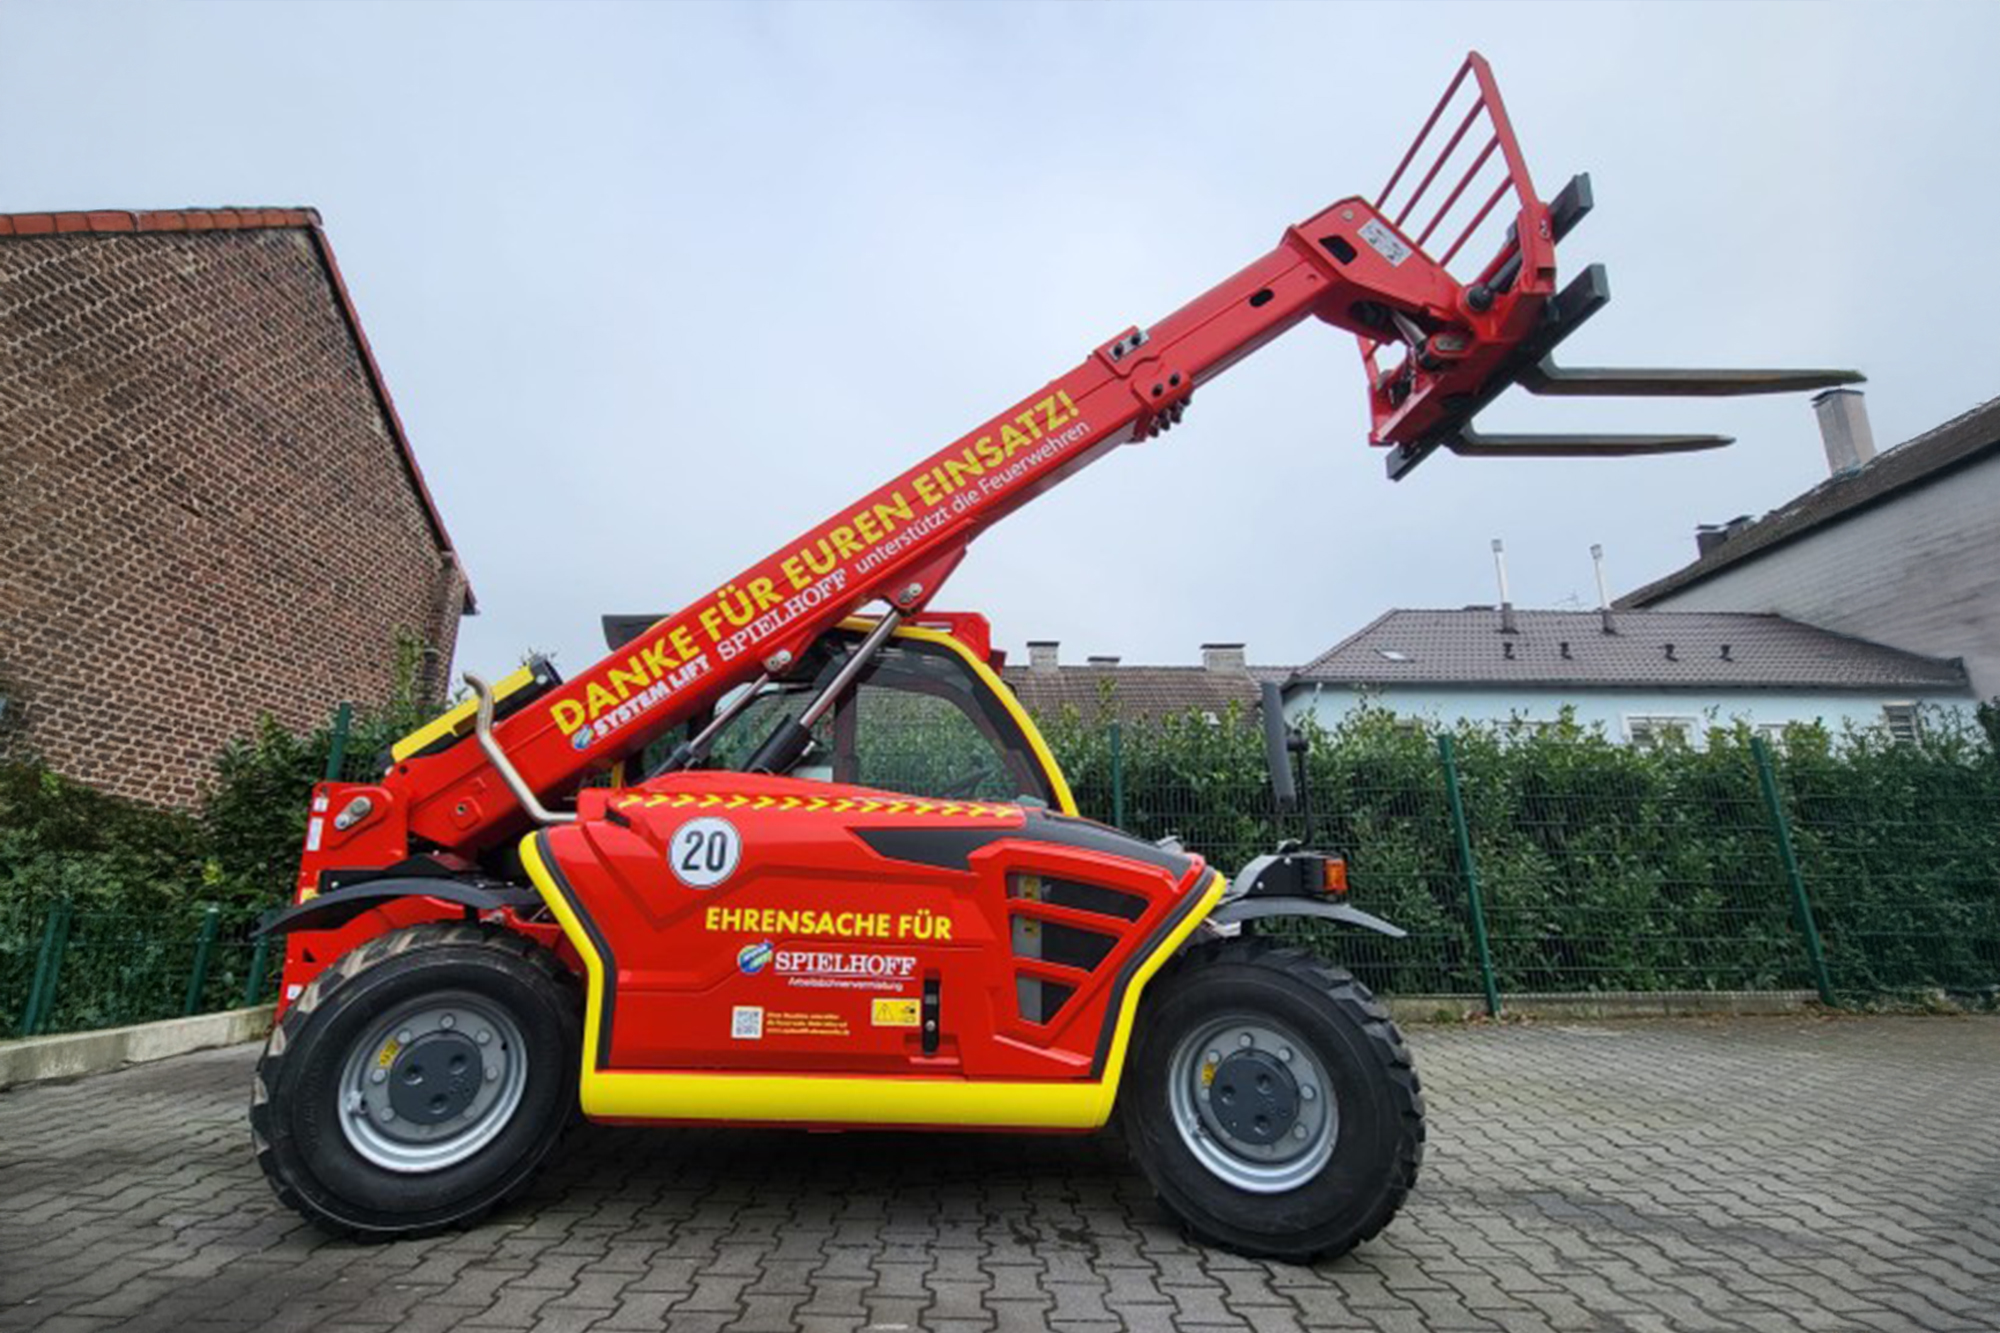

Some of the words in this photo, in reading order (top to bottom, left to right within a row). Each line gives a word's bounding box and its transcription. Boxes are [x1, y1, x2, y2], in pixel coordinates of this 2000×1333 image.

[550, 625, 701, 735] DANKE
[699, 577, 784, 642] FÜR
[780, 491, 915, 590] EUREN
[911, 389, 1080, 507] EINSATZ!
[593, 680, 673, 739] SYSTEM
[667, 653, 711, 690] LIFT
[716, 568, 847, 661] SPIELHOFF
[854, 505, 952, 575] unterstützt
[952, 489, 981, 515] die
[978, 420, 1091, 495] Feuerwehren
[681, 830, 728, 872] 20
[705, 907, 891, 937] EHRENSACHE
[898, 909, 952, 939] FÜR
[775, 950, 917, 975] SPIELHOFF
